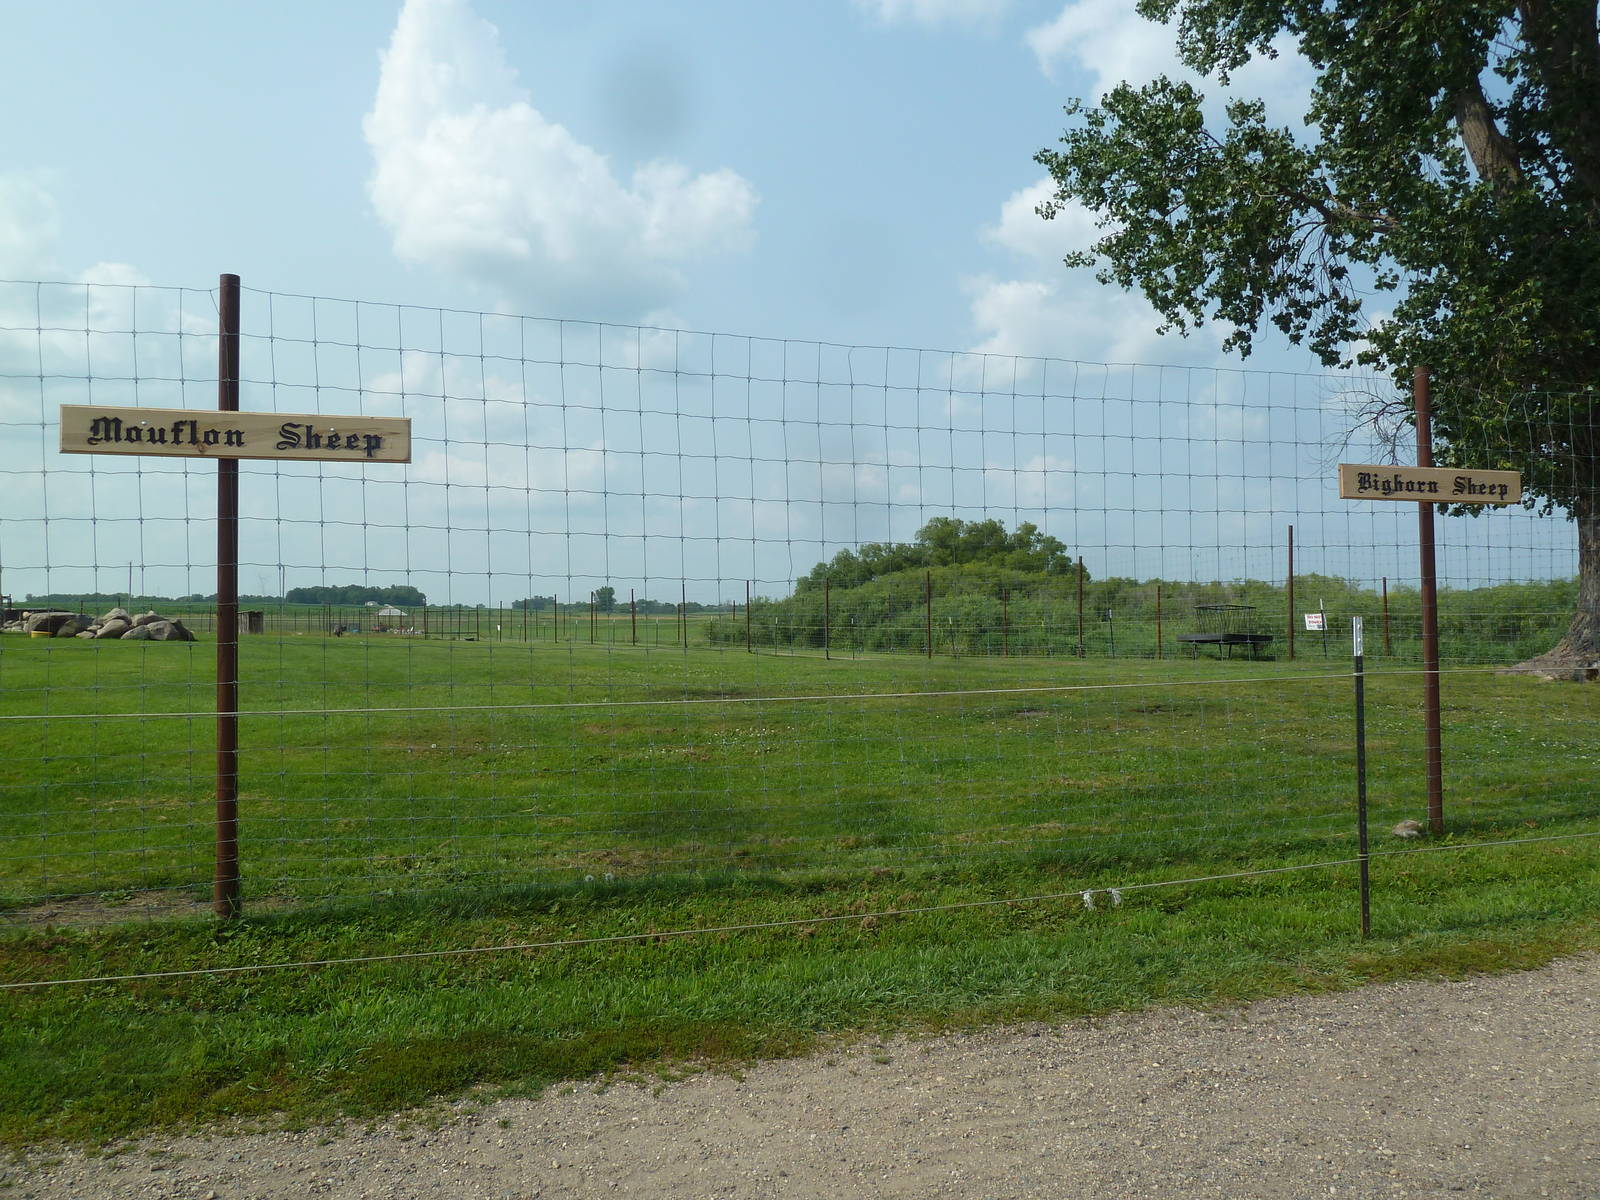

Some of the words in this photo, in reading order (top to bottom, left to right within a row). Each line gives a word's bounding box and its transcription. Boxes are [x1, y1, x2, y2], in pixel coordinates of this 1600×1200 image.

[87, 416, 245, 448] Mouflon
[276, 422, 384, 457] Sheep
[1357, 472, 1440, 496] Bighorn
[1452, 475, 1509, 500] Sheep
